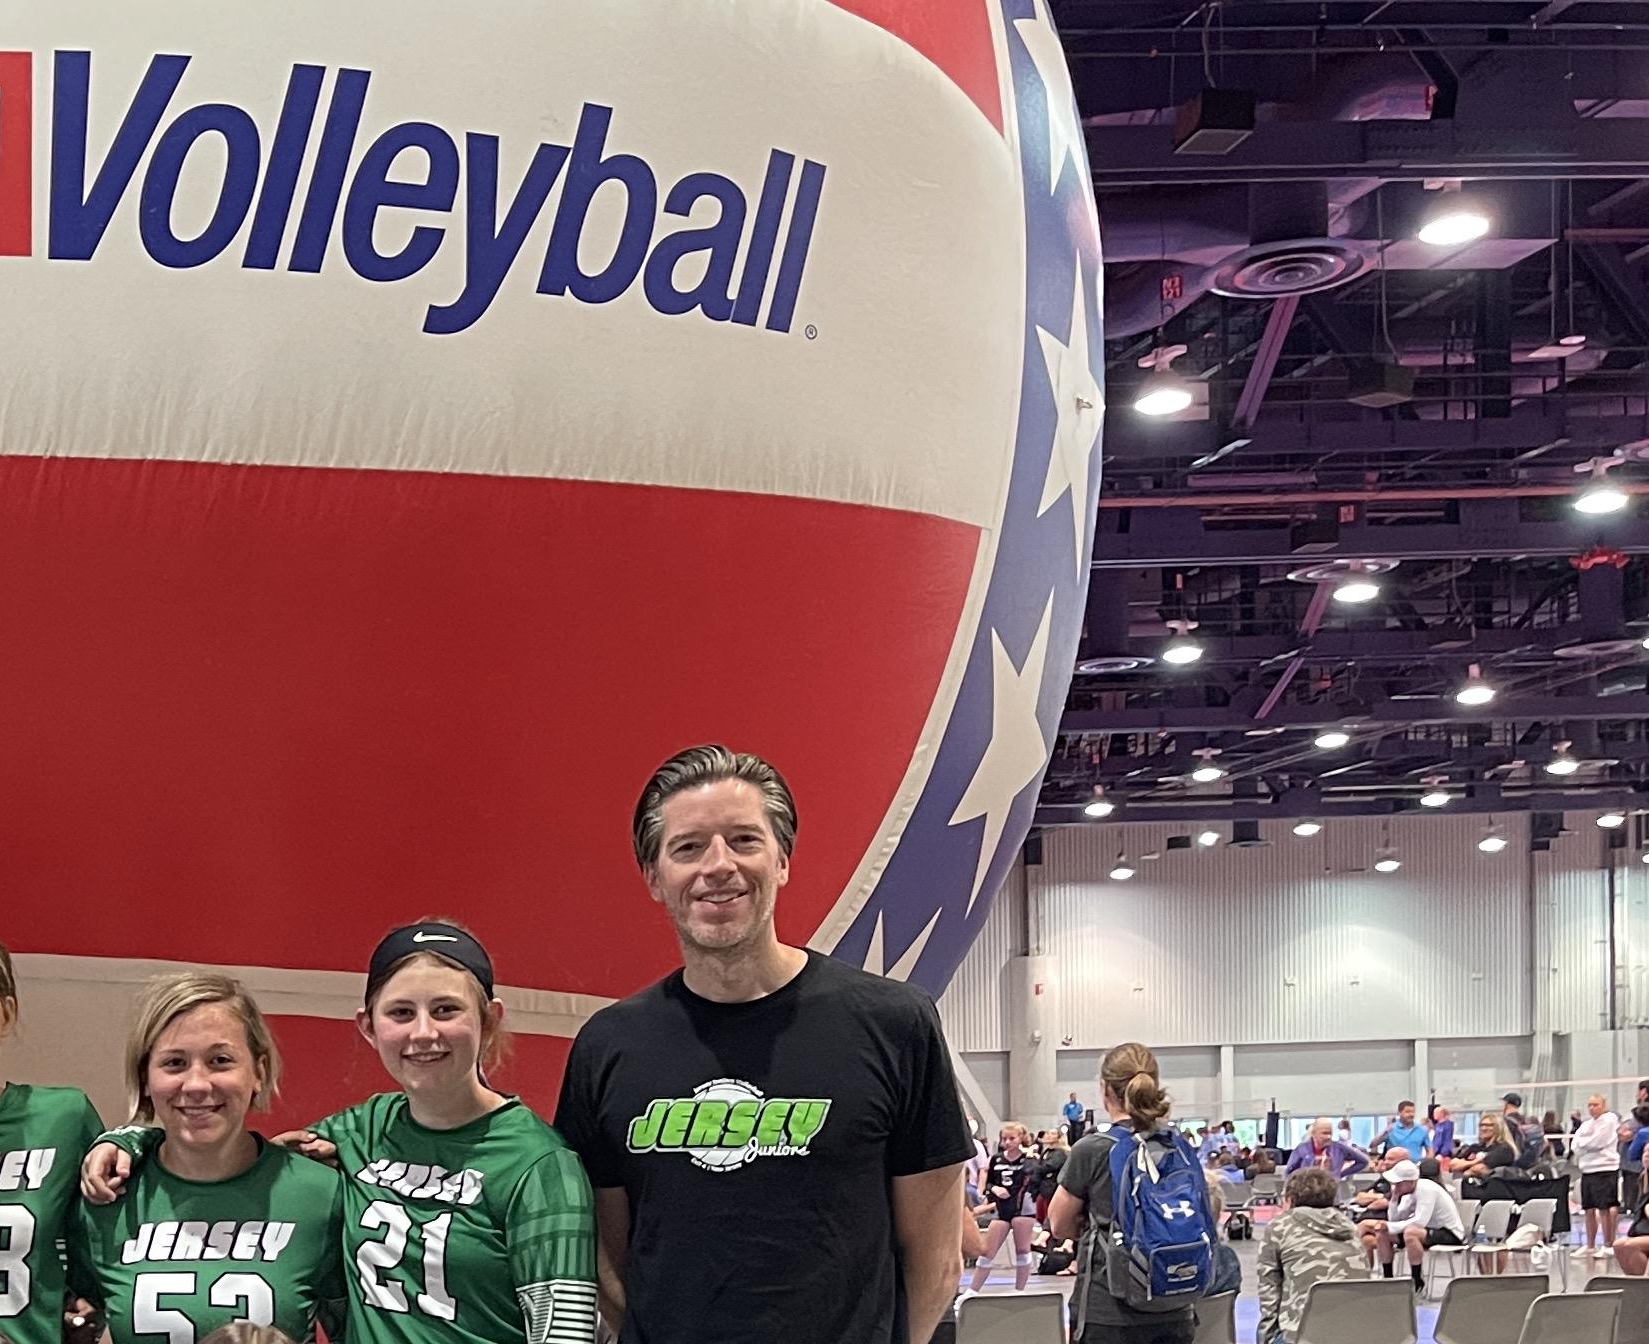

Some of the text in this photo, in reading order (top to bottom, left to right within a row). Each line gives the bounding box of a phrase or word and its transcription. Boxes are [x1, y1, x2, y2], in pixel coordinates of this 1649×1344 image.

[627, 1098, 832, 1153] JERSEY
[744, 1137, 810, 1163] Juniors
[121, 1220, 296, 1264] JERSEY
[355, 1199, 457, 1321] 21
